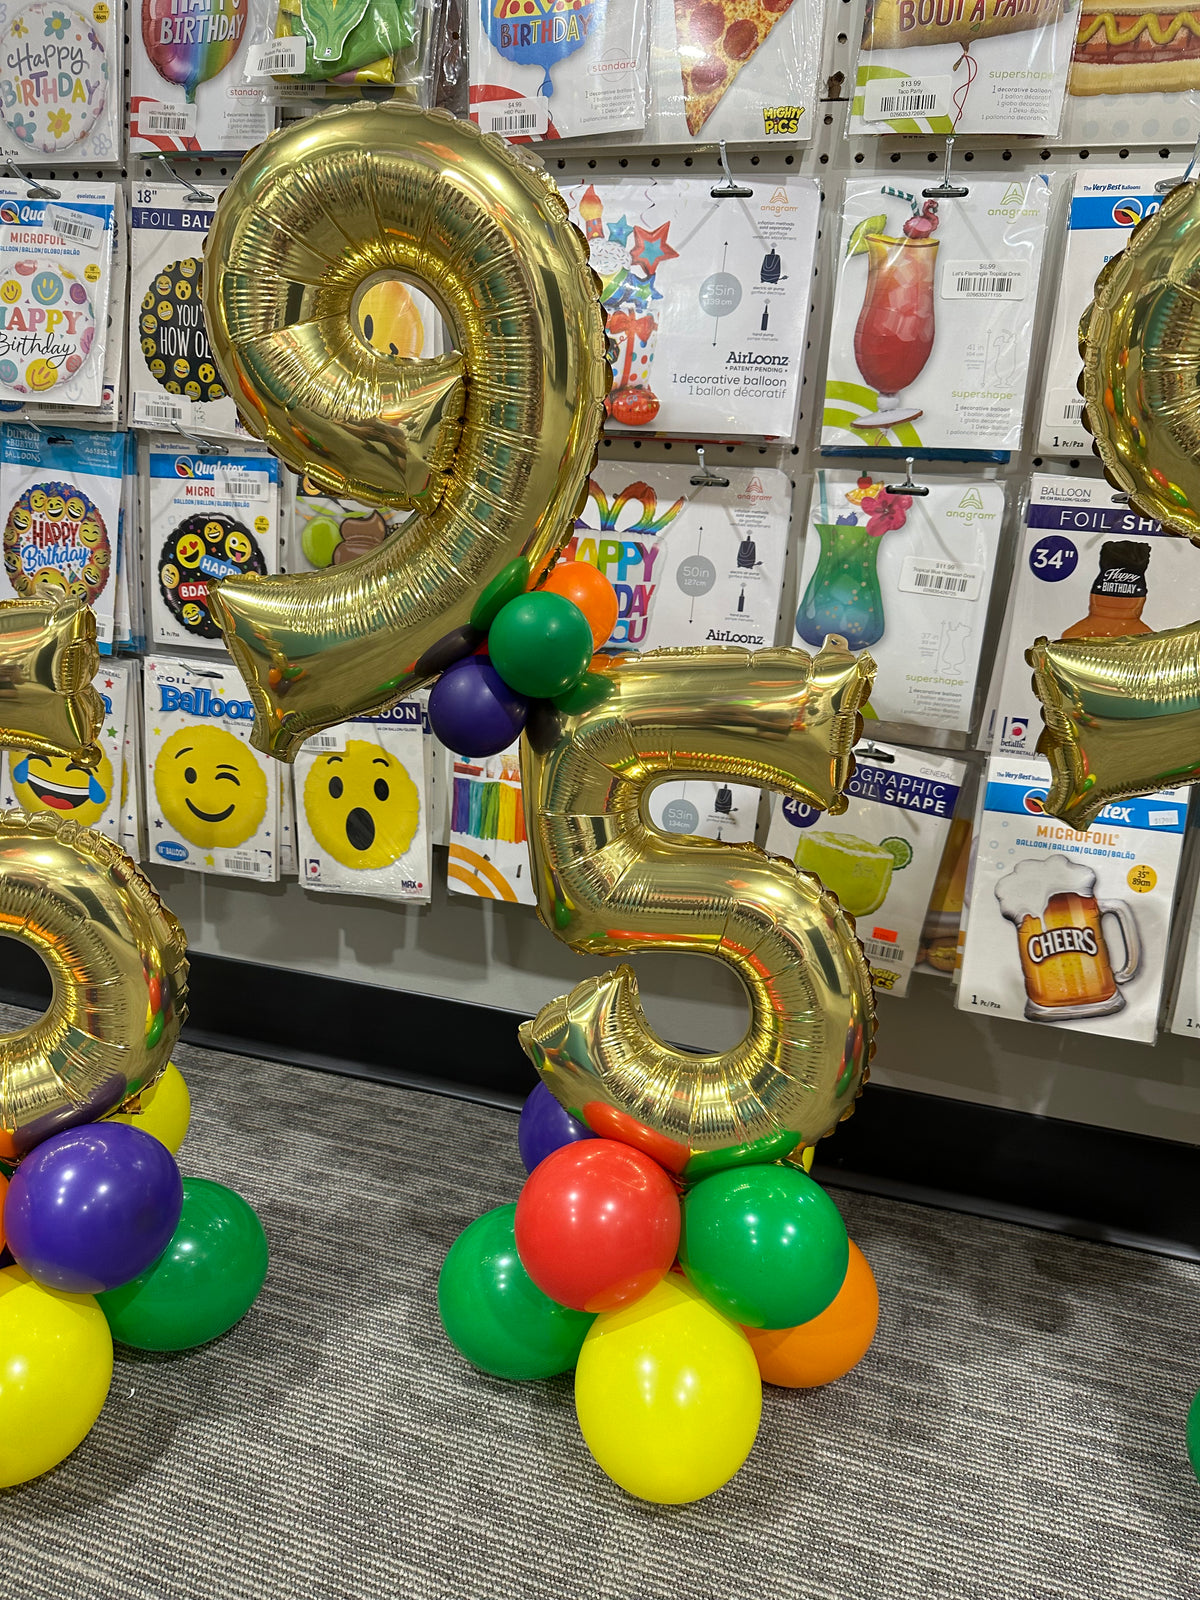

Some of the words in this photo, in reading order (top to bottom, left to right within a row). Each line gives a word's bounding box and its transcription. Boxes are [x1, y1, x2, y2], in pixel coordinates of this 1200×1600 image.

[160, 14, 244, 45] BIRTHDAY
[500, 14, 593, 49] BIRTHDAY
[7, 43, 90, 75] Happy
[592, 60, 637, 73] standard
[900, 80, 921, 88] $13.99
[1092, 183, 1106, 193] Very
[1107, 183, 1122, 191] Best
[137, 190, 158, 204] 18"
[760, 205, 798, 213] anagram
[988, 208, 1037, 219] anagram
[140, 211, 176, 227] FOIL
[160, 326, 191, 357] HOW
[726, 351, 789, 366] AirLoonz
[672, 374, 678, 383] 1
[680, 374, 741, 385] decorative
[744, 376, 787, 387] balloon
[689, 386, 694, 395] 1
[696, 386, 731, 396] ballon
[733, 388, 787, 399] décoratif
[952, 390, 1013, 400] supershape
[6, 428, 40, 442] burton
[1052, 436, 1059, 447] 1
[1062, 440, 1084, 448] Pc/Pza
[5, 451, 41, 463] BALLOONS
[737, 493, 772, 502] anagram
[1041, 486, 1091, 498] BALLOON
[946, 510, 993, 521] anagram
[1059, 511, 1112, 529] FOIL
[32, 520, 80, 550] HAPPY
[22, 542, 89, 572] Birthday
[1033, 549, 1074, 569] 34"
[682, 566, 710, 578] 50in
[1104, 567, 1141, 583] Happy
[1102, 582, 1137, 596] BIRTHDAY
[161, 628, 165, 636] 1
[706, 629, 764, 645] AirLoonz
[157, 675, 191, 685] FOIL
[905, 674, 964, 687] supershape
[1000, 739, 1026, 749] betallic
[920, 767, 955, 781] GENERAL
[1005, 772, 1018, 780] Very
[884, 789, 946, 813] SHAPE
[668, 808, 694, 820] 53in
[1036, 825, 1116, 846] MICROFOIL
[1138, 871, 1149, 879] 35"
[1132, 878, 1151, 887] 89cm
[1028, 927, 1098, 963] CHEERS
[869, 966, 902, 981] IGHTY
[971, 995, 978, 1005] 1
[980, 1000, 1001, 1010] Pc/Pza
[1186, 1018, 1193, 1028] 1
